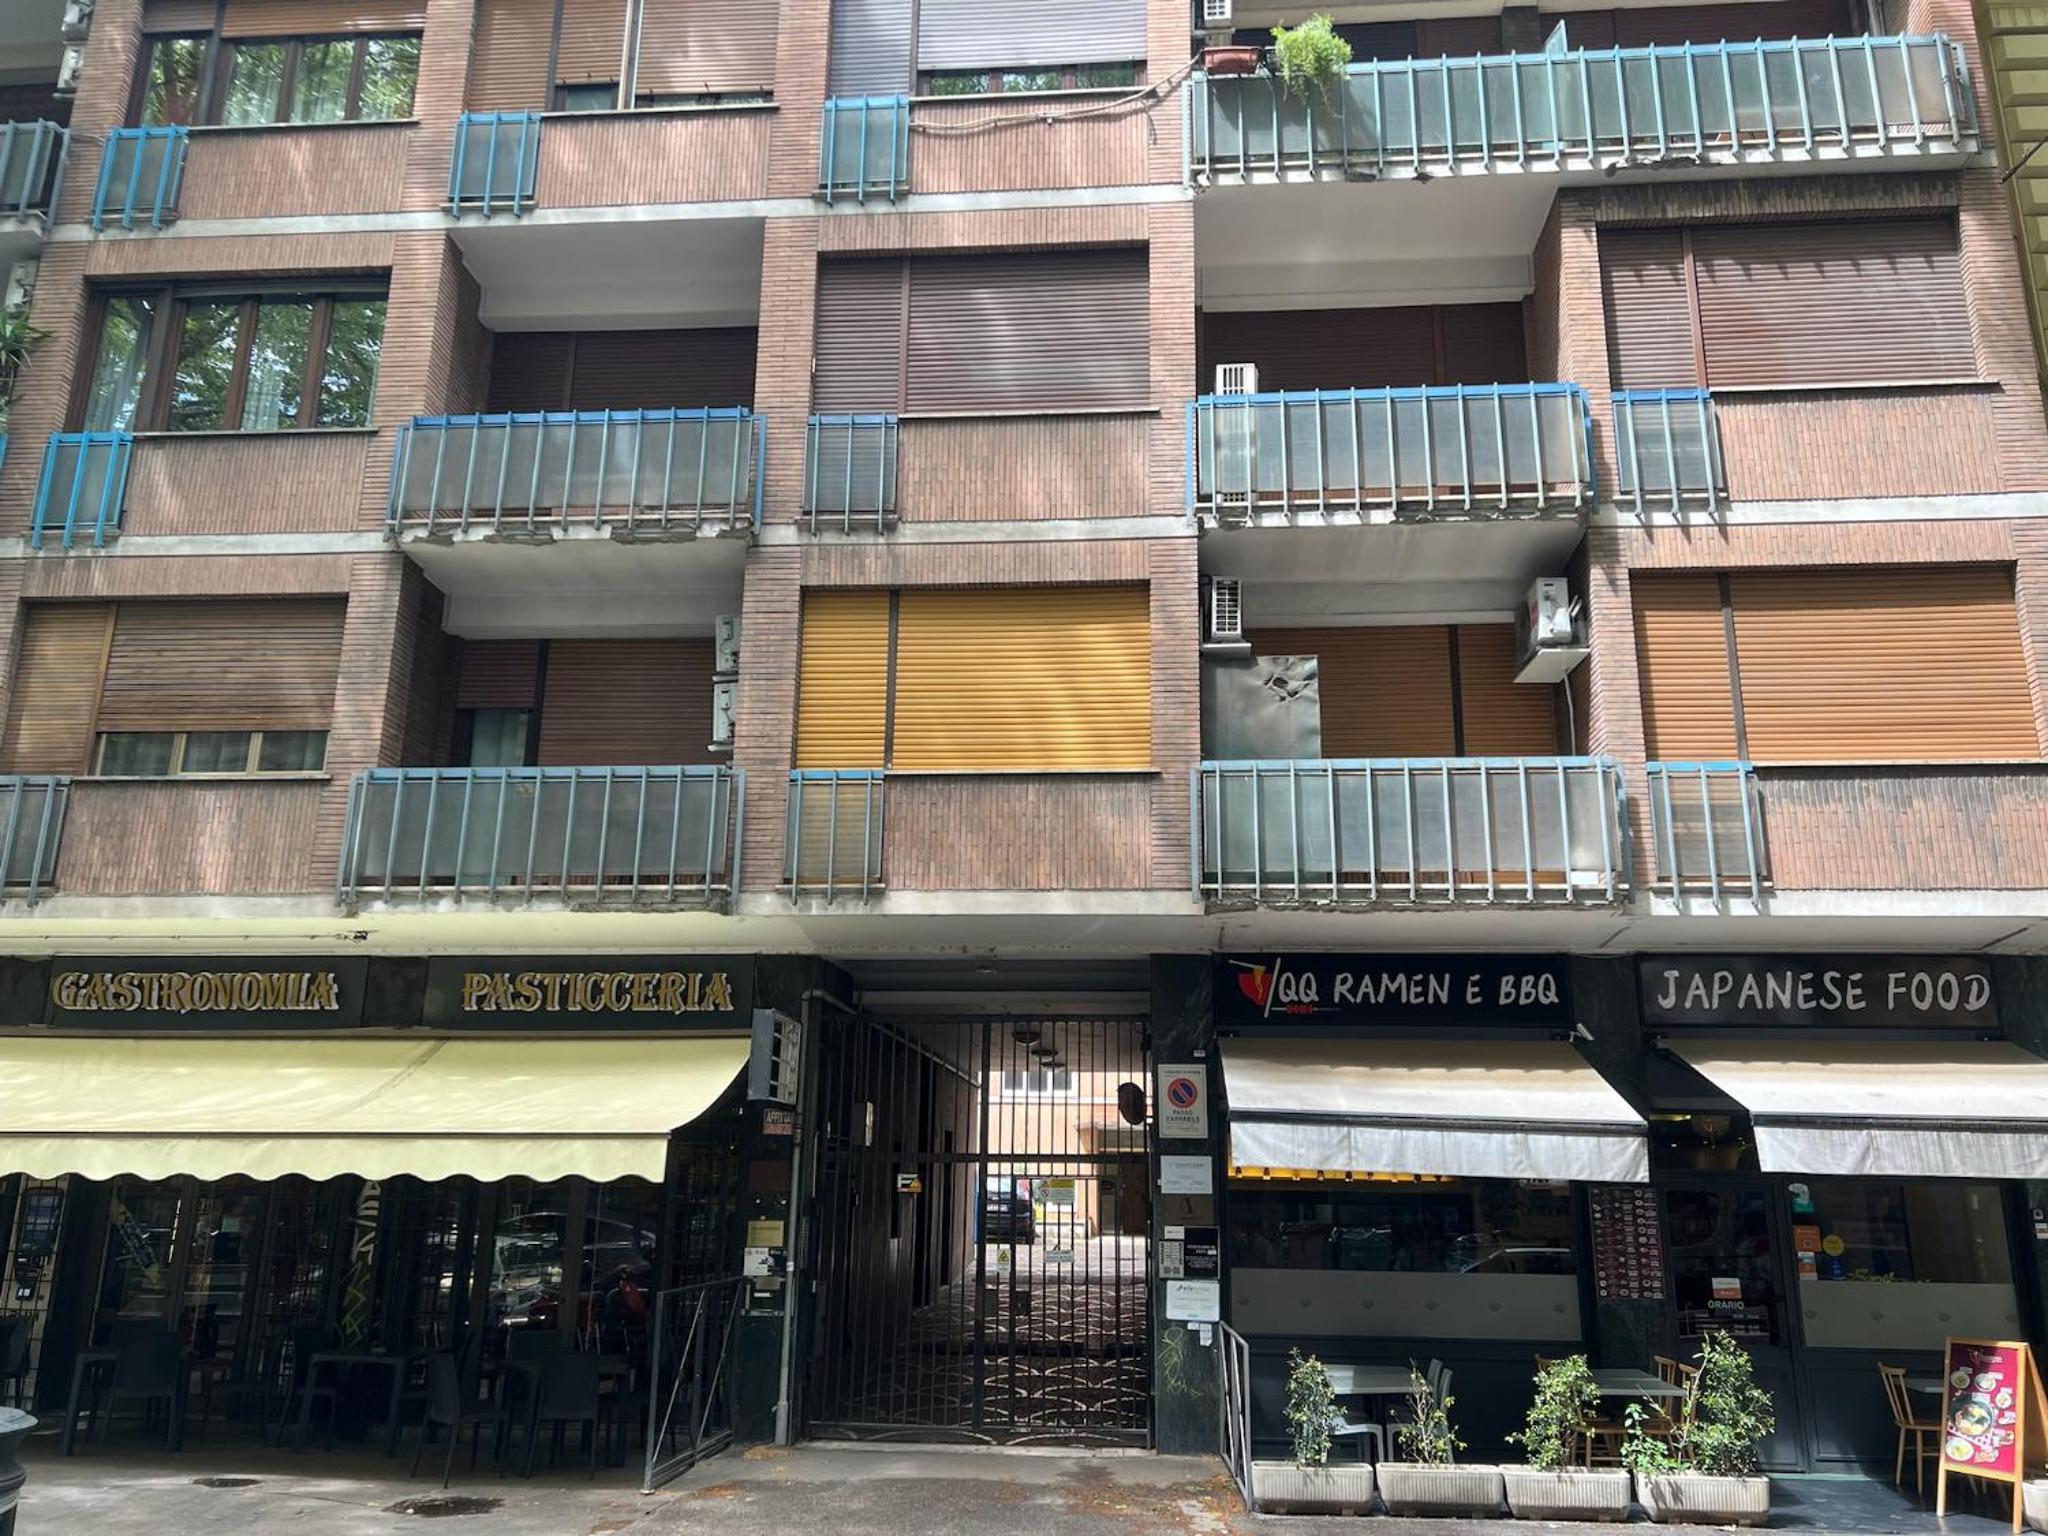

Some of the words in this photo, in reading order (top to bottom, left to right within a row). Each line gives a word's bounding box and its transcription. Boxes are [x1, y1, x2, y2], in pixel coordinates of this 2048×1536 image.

[52, 970, 340, 1013] GASTRONOMIA
[461, 970, 735, 1013] PASTICCERIA
[1278, 971, 1320, 1004] QQ
[1333, 972, 1449, 1004] RAMEN
[1465, 974, 1483, 1005] E
[1498, 972, 1559, 1005] BBQ
[1657, 970, 1867, 1010] JAPANESE
[1886, 972, 1991, 1012] FOOD
[1707, 1300, 1745, 1310] ORARIO
